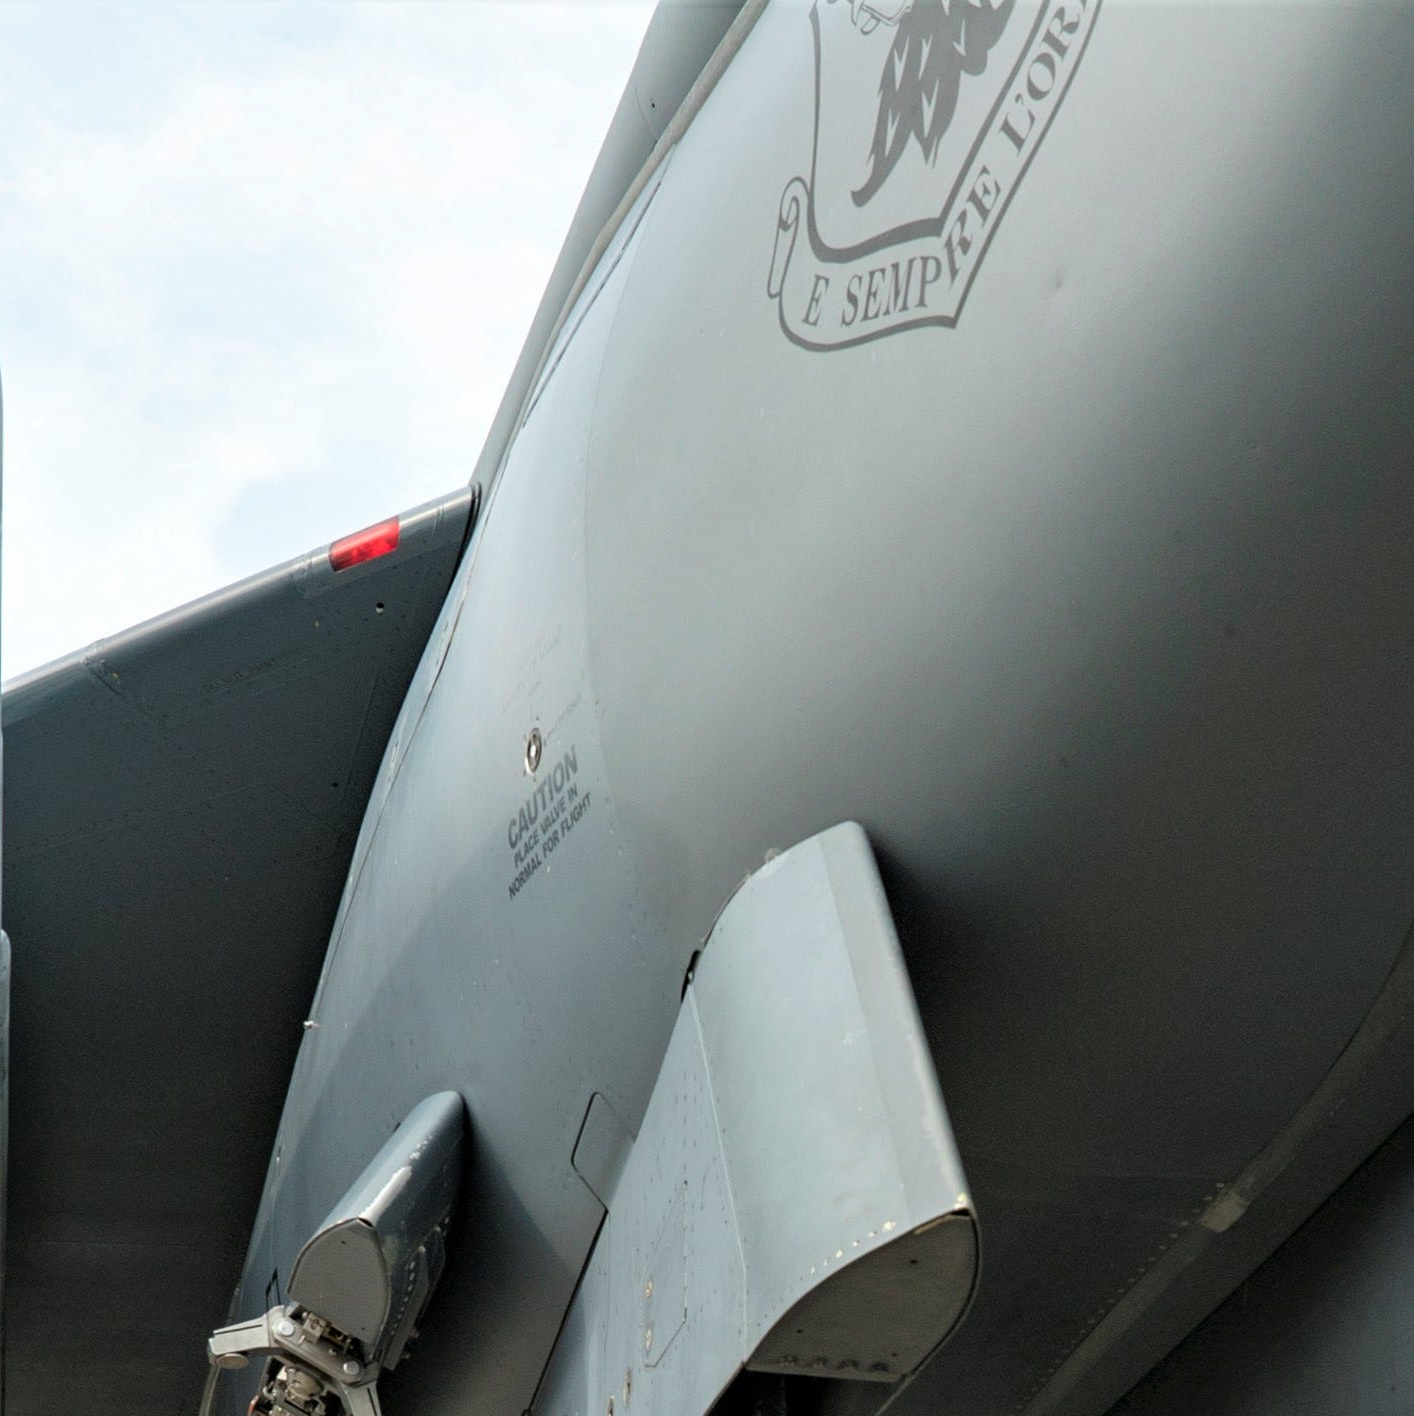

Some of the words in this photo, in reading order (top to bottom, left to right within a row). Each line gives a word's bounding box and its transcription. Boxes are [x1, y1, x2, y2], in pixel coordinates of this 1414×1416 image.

[840, 165, 1001, 327] SEMPRE
[997, 0, 1087, 158] L'OR
[508, 744, 578, 849] CAUTION
[508, 852, 542, 899] NORMAL
[542, 829, 560, 859] FOR
[560, 791, 591, 837] FLIGHT
[514, 830, 540, 868] PLACE
[540, 796, 566, 835] VALVE
[566, 782, 578, 804] IN
